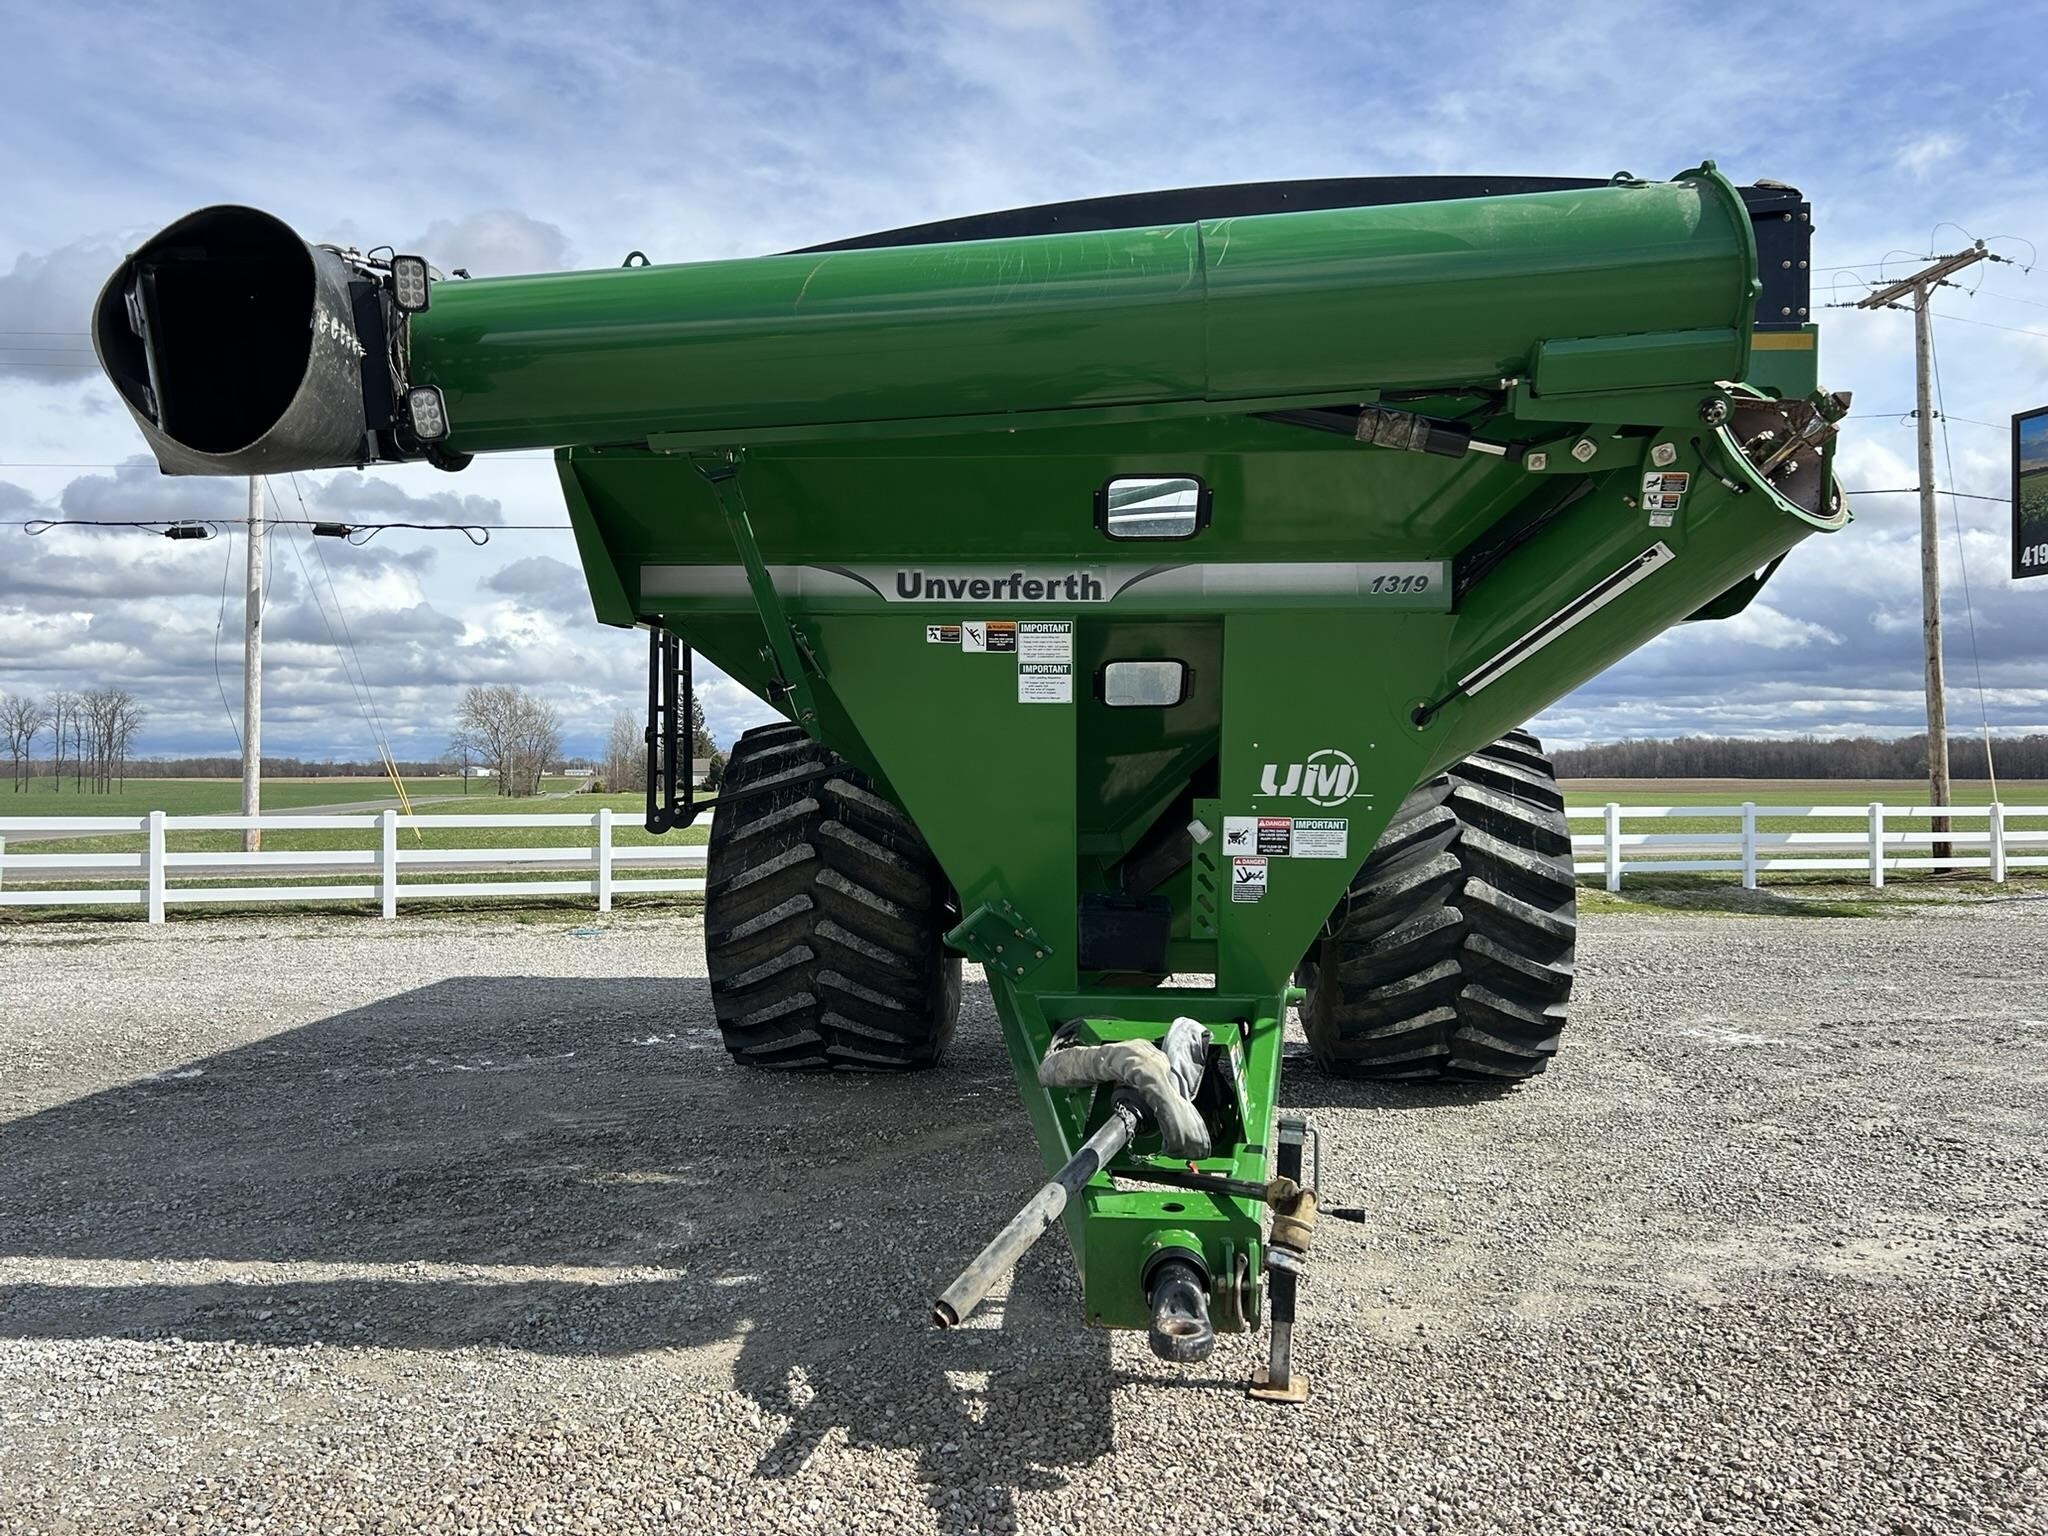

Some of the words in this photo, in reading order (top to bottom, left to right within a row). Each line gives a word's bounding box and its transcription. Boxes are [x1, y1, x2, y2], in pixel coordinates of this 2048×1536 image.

[896, 571, 1102, 600] Unverferth
[1371, 575, 1429, 593] 1319
[1021, 623, 1070, 633] IMPORTANT
[1022, 665, 1068, 673] IMPORTANT
[1295, 820, 1345, 829] IMPORTANT
